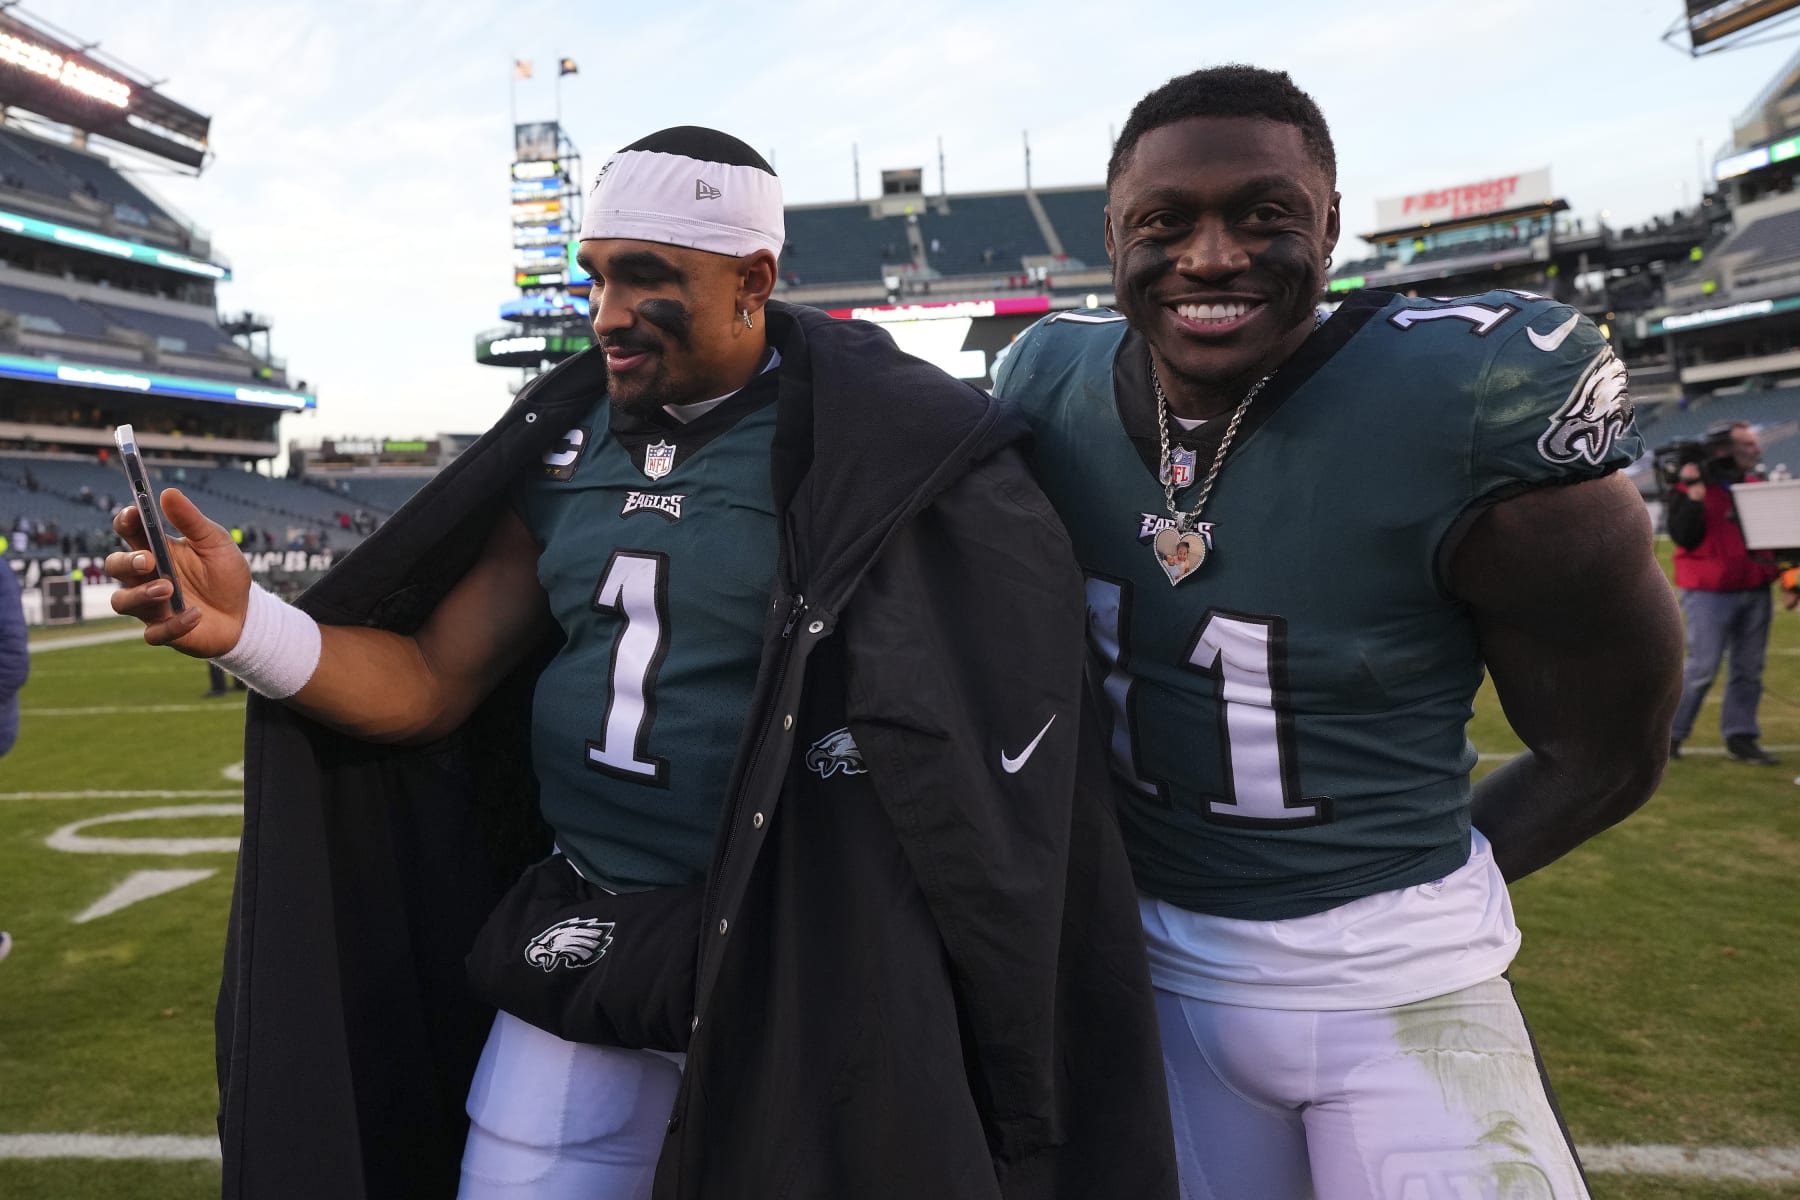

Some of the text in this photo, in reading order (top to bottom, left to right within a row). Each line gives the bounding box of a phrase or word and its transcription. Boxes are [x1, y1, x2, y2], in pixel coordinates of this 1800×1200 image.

[1402, 175, 1520, 215] FIRSTRUST
[649, 456, 668, 473] NFL
[621, 491, 687, 519] EAGLES
[586, 551, 665, 782] 1
